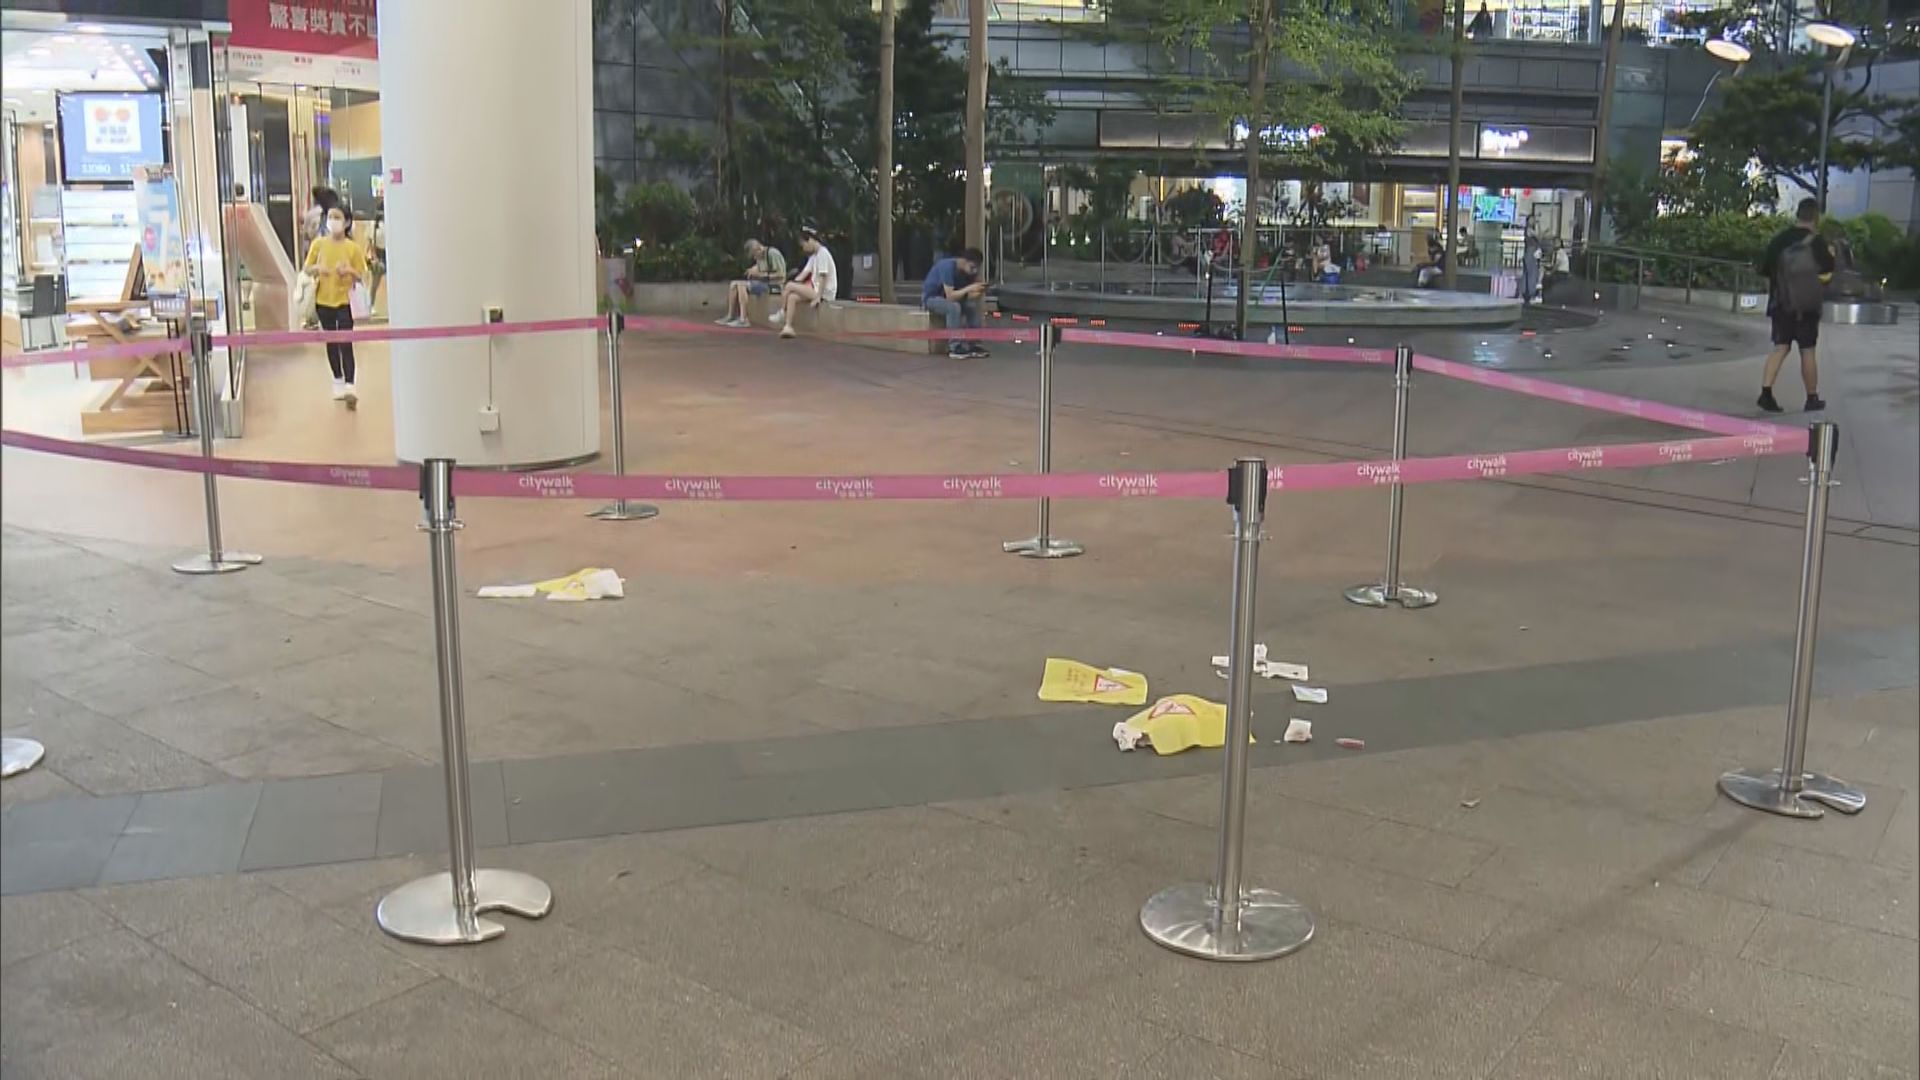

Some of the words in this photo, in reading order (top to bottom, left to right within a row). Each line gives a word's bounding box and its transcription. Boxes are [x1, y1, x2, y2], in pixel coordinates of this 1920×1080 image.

[1568, 448, 1603, 462] citywalk
[1658, 442, 1692, 457] citywalk
[1357, 463, 1400, 478] citywalk
[1467, 457, 1506, 471] citywalk
[519, 475, 574, 490] citywalk
[665, 478, 721, 492] citywalk
[816, 477, 874, 493] citywalk
[943, 475, 1001, 490] citywalk
[1099, 475, 1158, 489] citywalk
